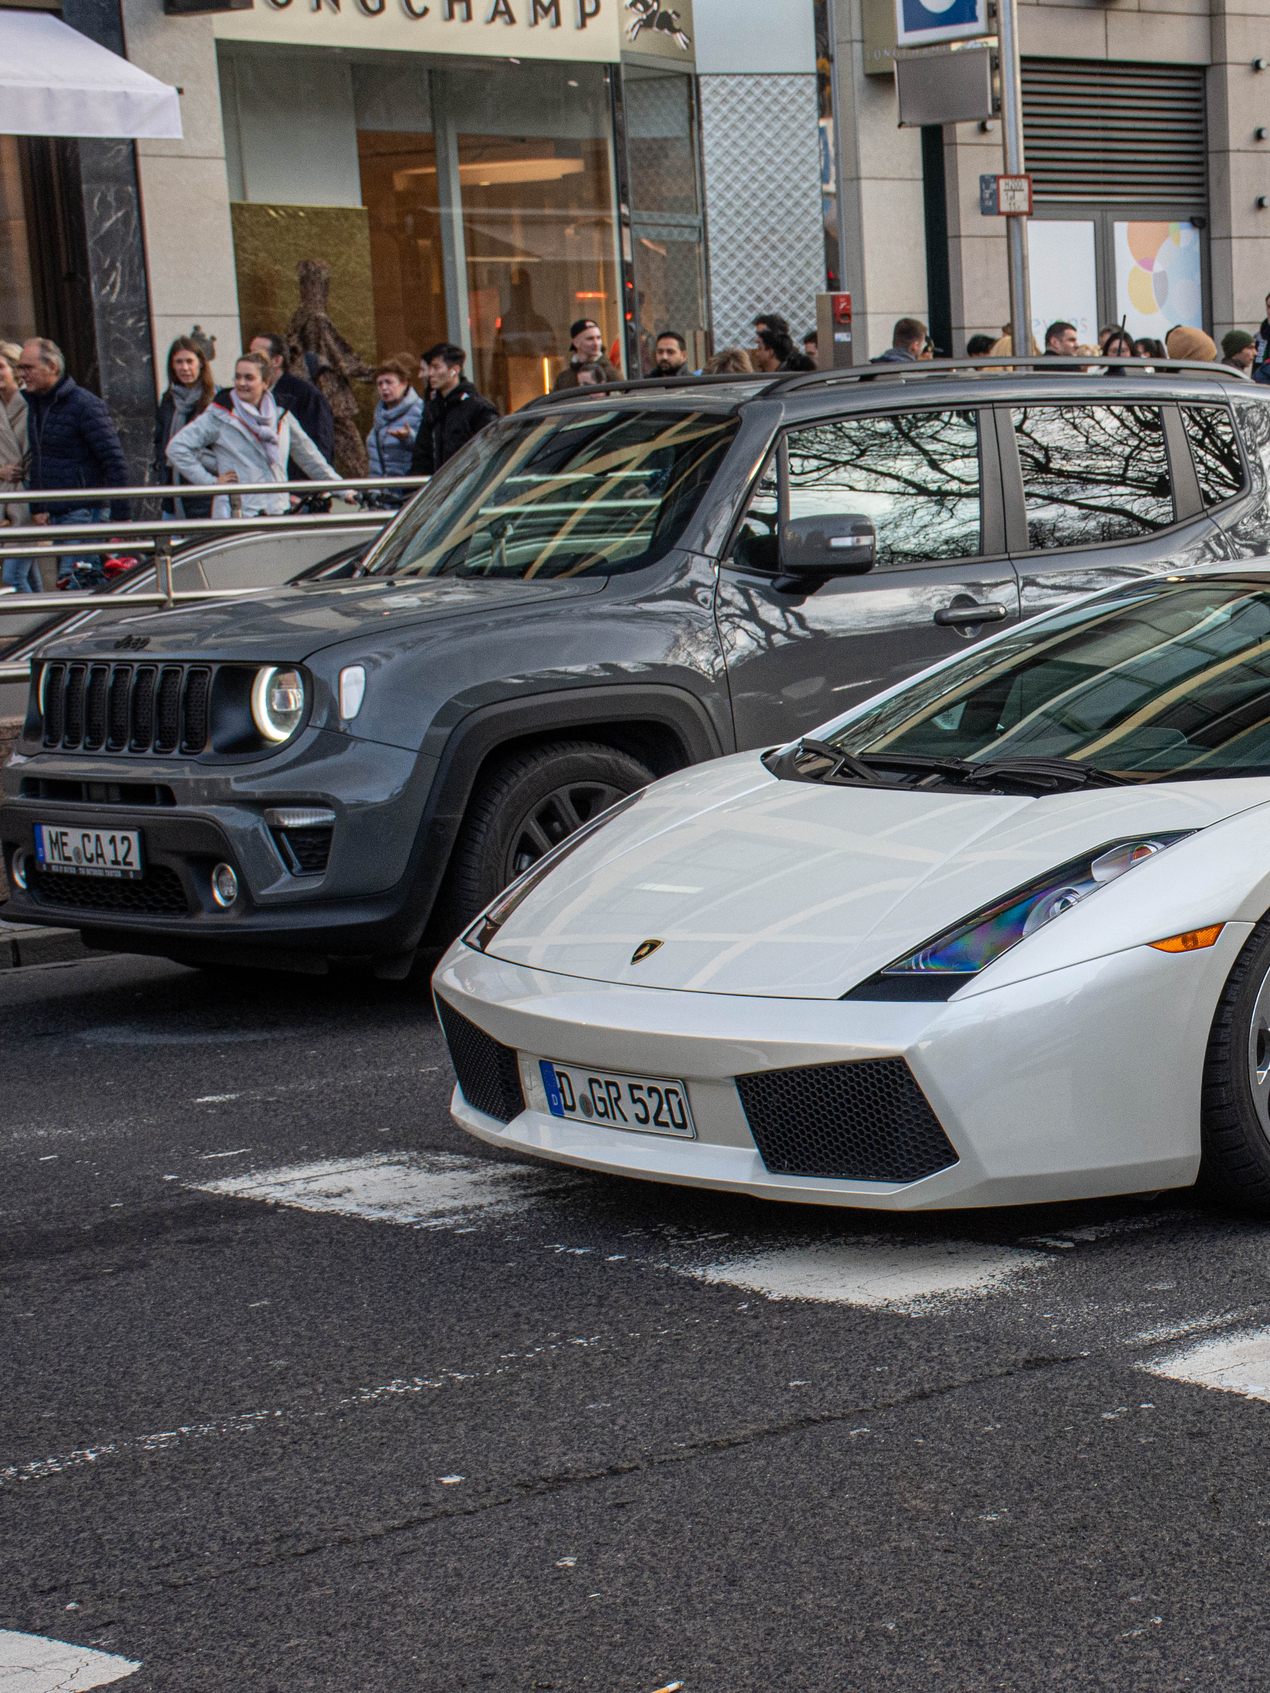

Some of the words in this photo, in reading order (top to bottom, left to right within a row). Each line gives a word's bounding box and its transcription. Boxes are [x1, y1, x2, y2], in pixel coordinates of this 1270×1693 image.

[114, 634, 151, 652] Jeep
[48, 829, 73, 863] ME
[81, 833, 107, 866] CA
[108, 834, 134, 867] 12
[555, 1070, 577, 1112] D
[588, 1076, 629, 1123] GR
[627, 1082, 688, 1130] 520
